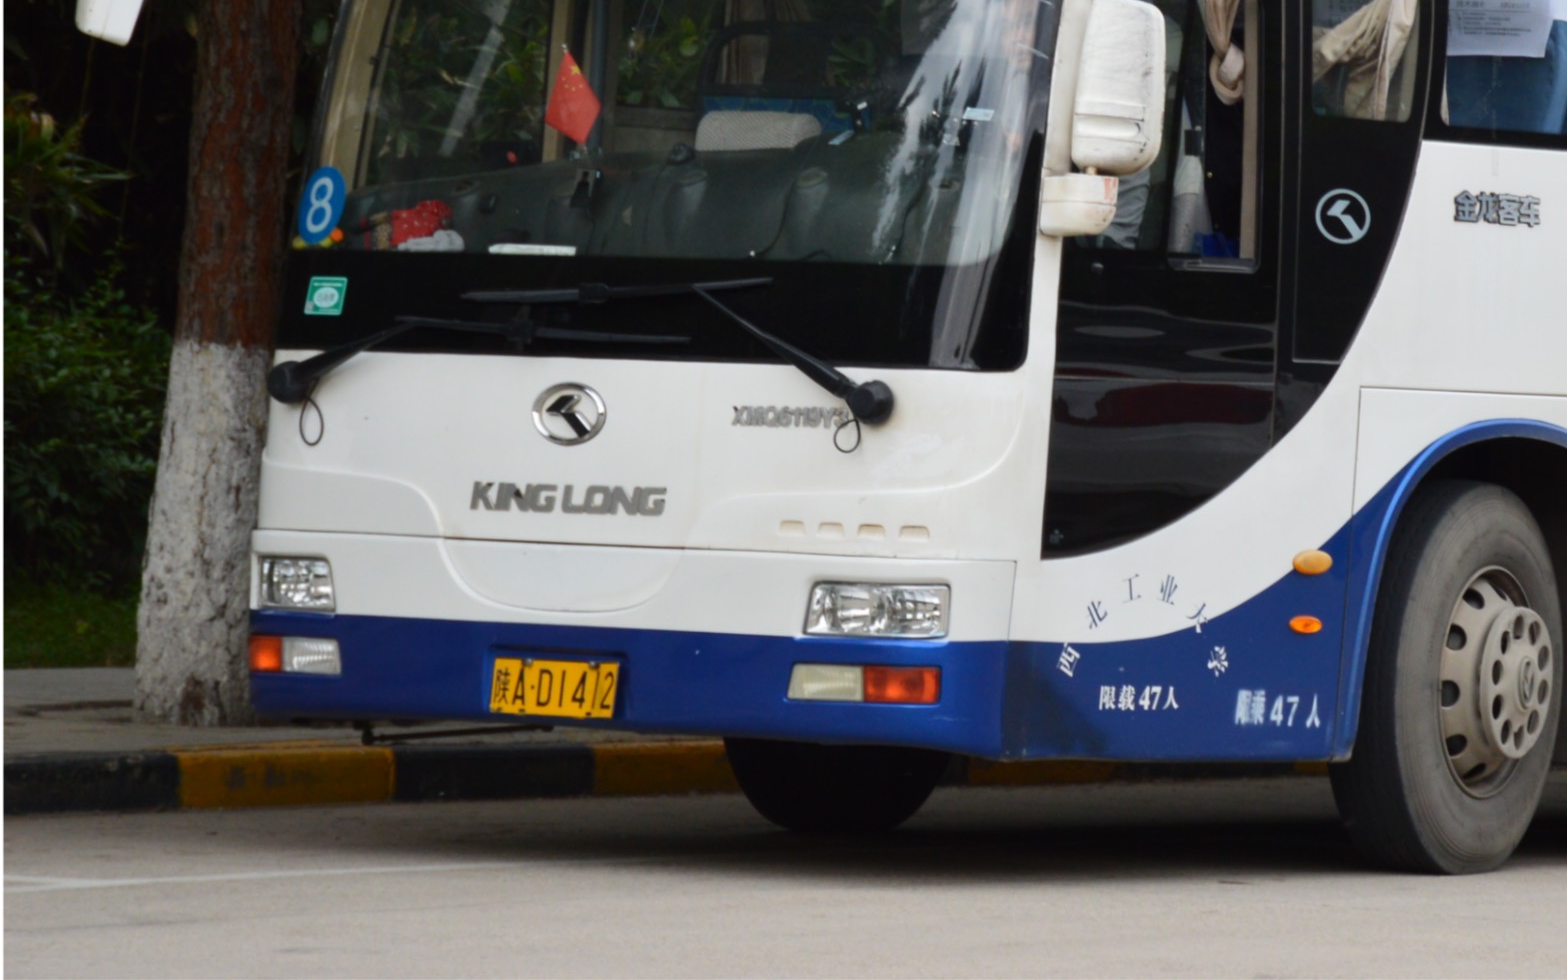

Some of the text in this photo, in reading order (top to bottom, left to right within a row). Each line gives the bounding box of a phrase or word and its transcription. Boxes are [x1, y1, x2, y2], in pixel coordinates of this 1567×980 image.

[306, 176, 334, 233] 8
[1453, 189, 1541, 228] 金龙客车
[469, 481, 667, 517] KING LONG
